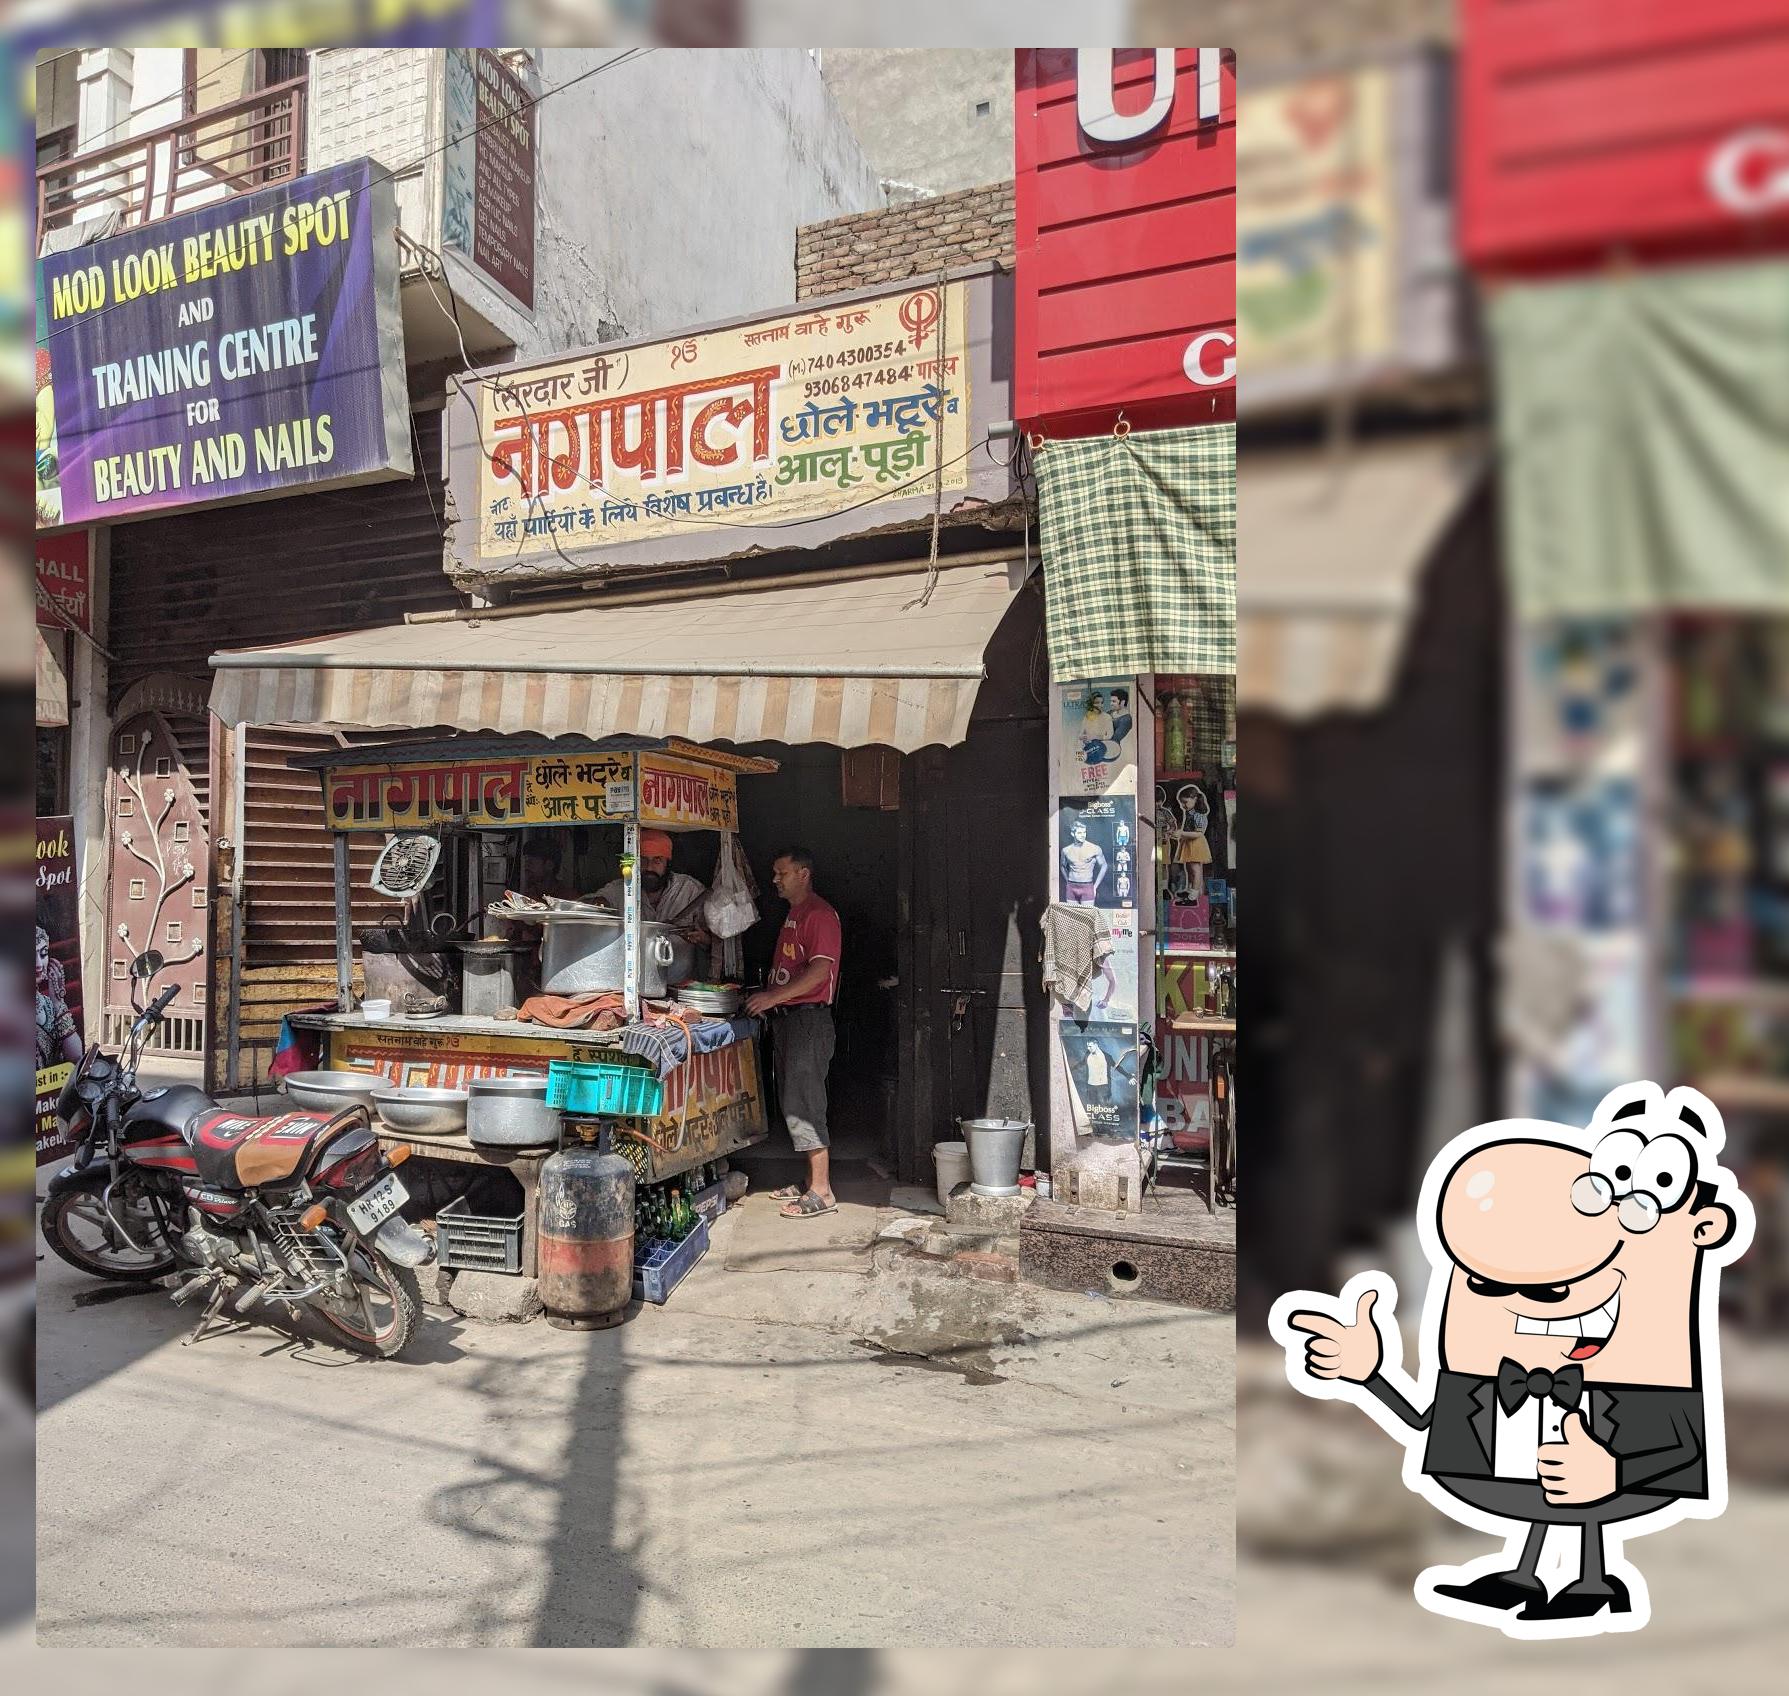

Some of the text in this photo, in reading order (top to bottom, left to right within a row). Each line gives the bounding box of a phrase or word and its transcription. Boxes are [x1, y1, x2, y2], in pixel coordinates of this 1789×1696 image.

[479, 56, 499, 90] MOD
[480, 81, 530, 151] BEAUTY SPOT
[479, 160, 492, 180] AND
[503, 182, 520, 207] TYPES
[489, 152, 512, 182] MAKEUP
[509, 157, 531, 184] MAKEUP
[478, 176, 512, 212] OF MAKEUP
[479, 193, 518, 237] ACRYLIC NAILS
[479, 209, 506, 242] GEL NAILS
[53, 190, 352, 320] MOD LOOK BEAUTY SPOT
[478, 224, 528, 279] TEMPORARY NAILS
[478, 242, 502, 272] NAIL ART
[178, 297, 214, 328] AND
[92, 314, 319, 410] TRAINING CENTRE
[1183, 332, 1236, 385] G
[187, 398, 220, 427] FOR
[492, 365, 780, 500] नागपाल
[93, 415, 334, 503] BEAUTY AND NAILS
[579, 504, 596, 529] के
[600, 498, 638, 528] लिये
[643, 490, 692, 518] विशेष
[696, 483, 754, 512] प्रबन्ध
[1081, 765, 1108, 779] FREE
[330, 762, 528, 820] नागपाल
[36, 865, 71, 890] Spot
[50, 1071, 58, 1084] in
[1086, 1104, 1116, 1114] Bigboss
[359, 1184, 392, 1214] HR 12 S
[370, 1200, 395, 1222] 9189
[559, 1220, 576, 1229] GAS
